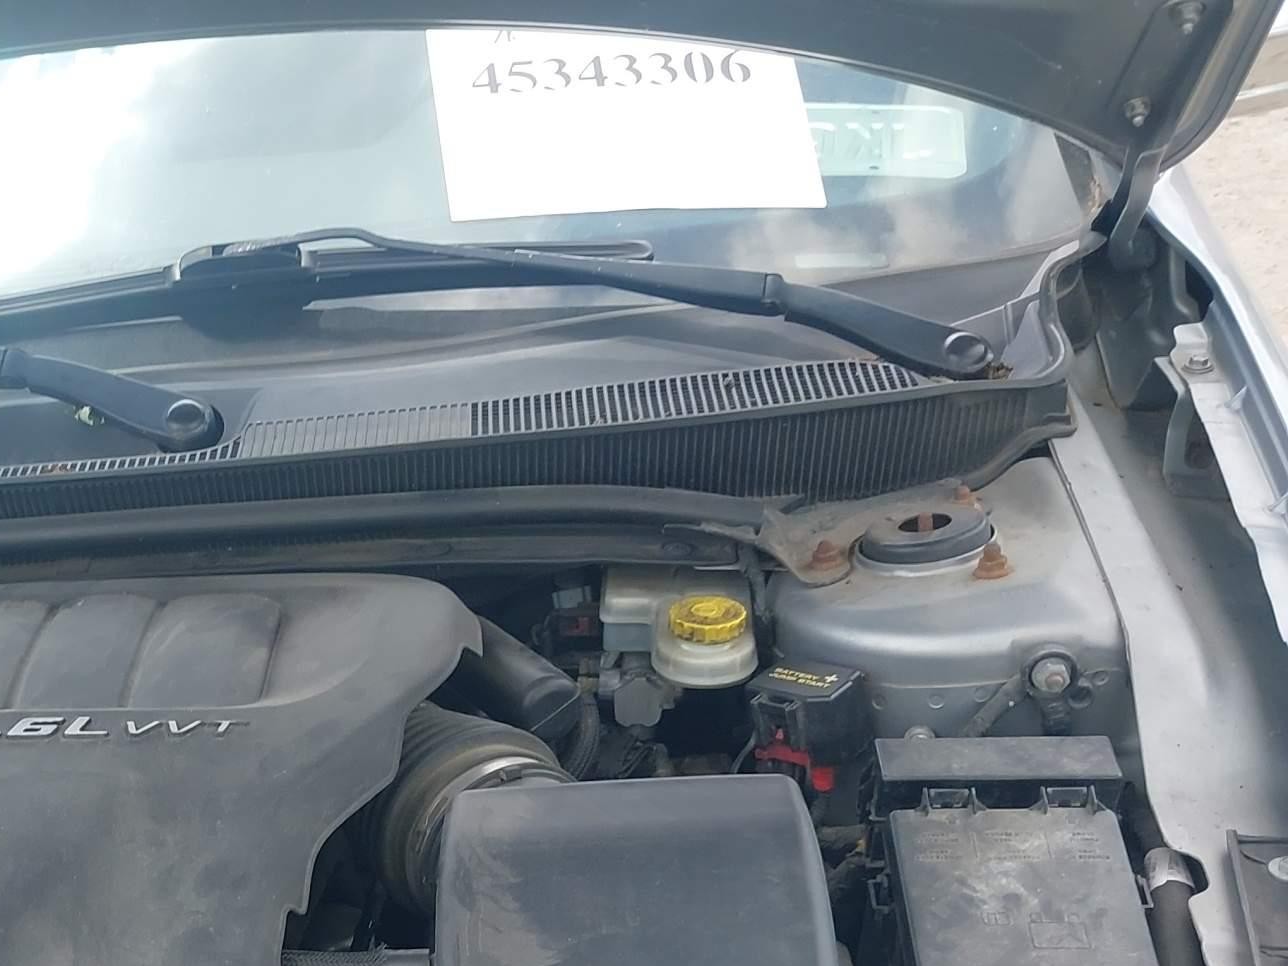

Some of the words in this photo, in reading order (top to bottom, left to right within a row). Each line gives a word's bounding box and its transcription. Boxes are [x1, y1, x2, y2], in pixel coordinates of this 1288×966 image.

[472, 48, 751, 94] 45343306
[775, 668, 821, 680] BATTERY
[125, 719, 249, 737] VVT
